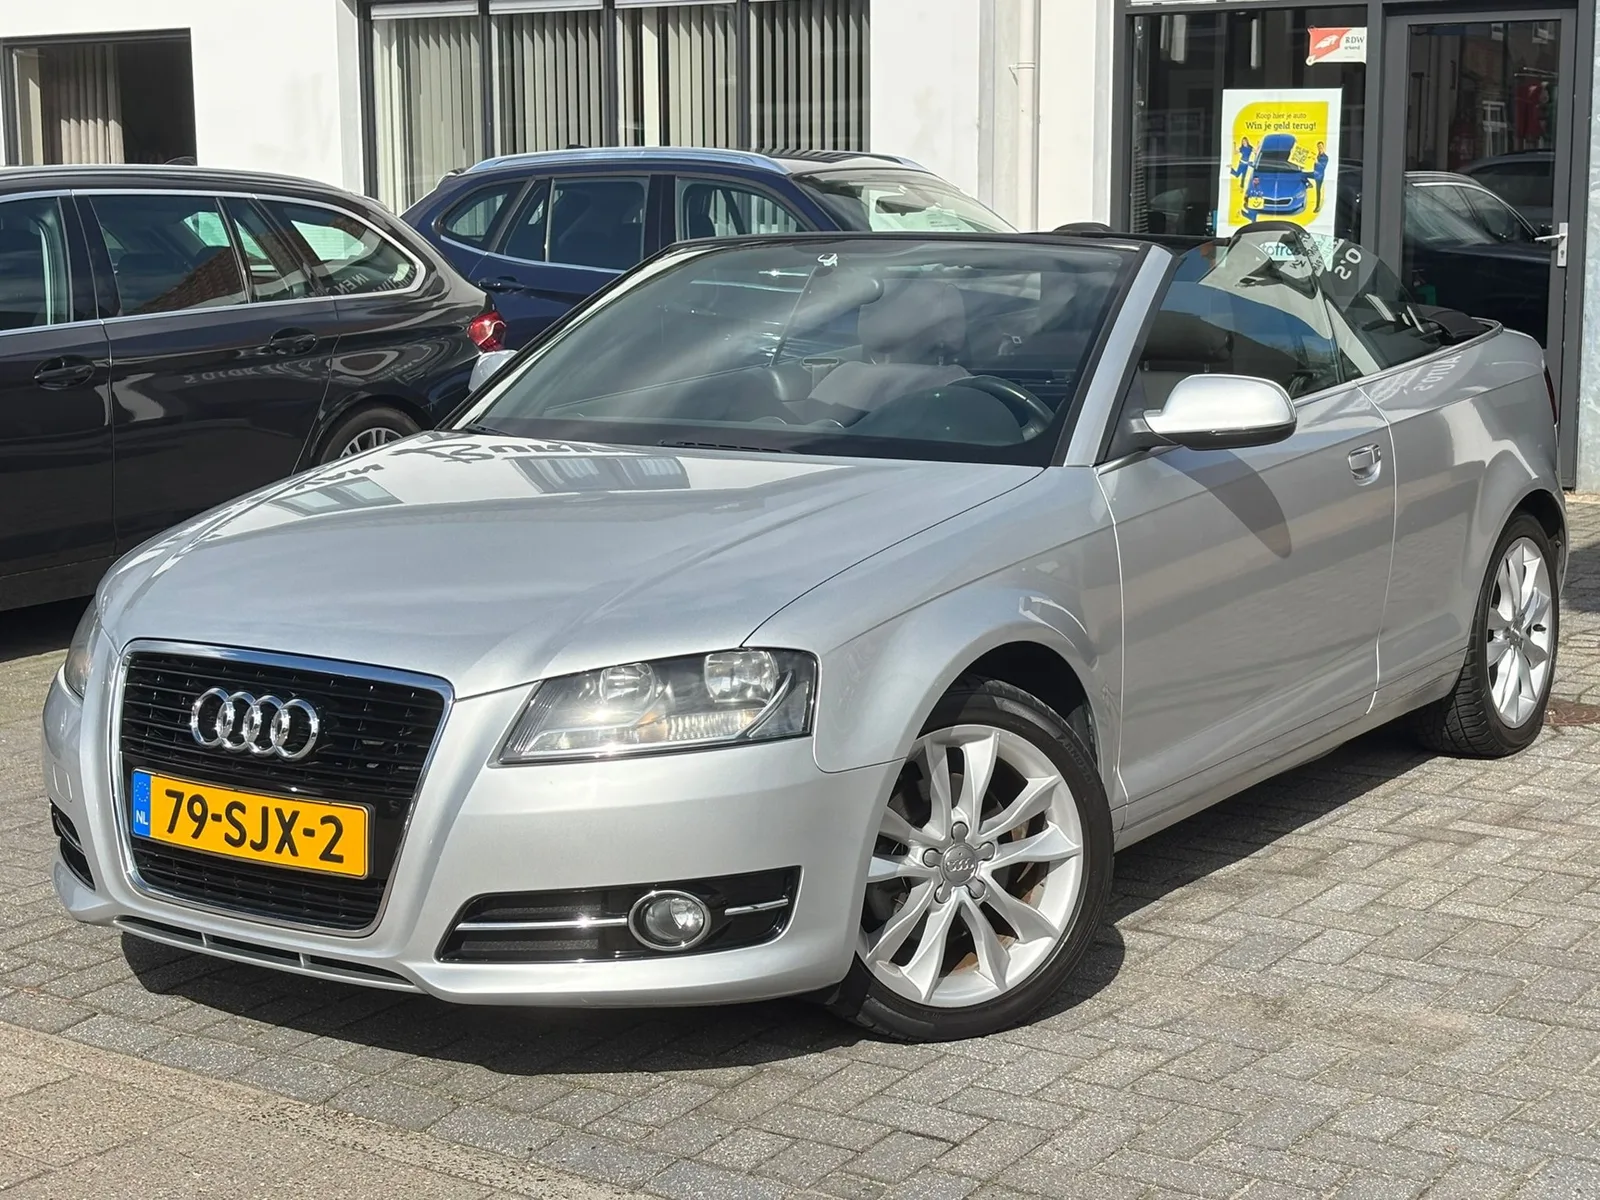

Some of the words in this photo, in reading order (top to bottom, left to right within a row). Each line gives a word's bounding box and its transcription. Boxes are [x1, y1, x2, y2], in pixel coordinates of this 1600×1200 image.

[1345, 36, 1365, 44] RDW
[1256, 112, 1272, 120] Koop
[1286, 112, 1292, 120] je
[1245, 121, 1262, 129] Win
[1264, 121, 1271, 131] je
[1273, 121, 1290, 131] geld
[1292, 122, 1317, 131] terug!
[135, 811, 149, 826] NL
[164, 788, 345, 864] 79-SJX-2
